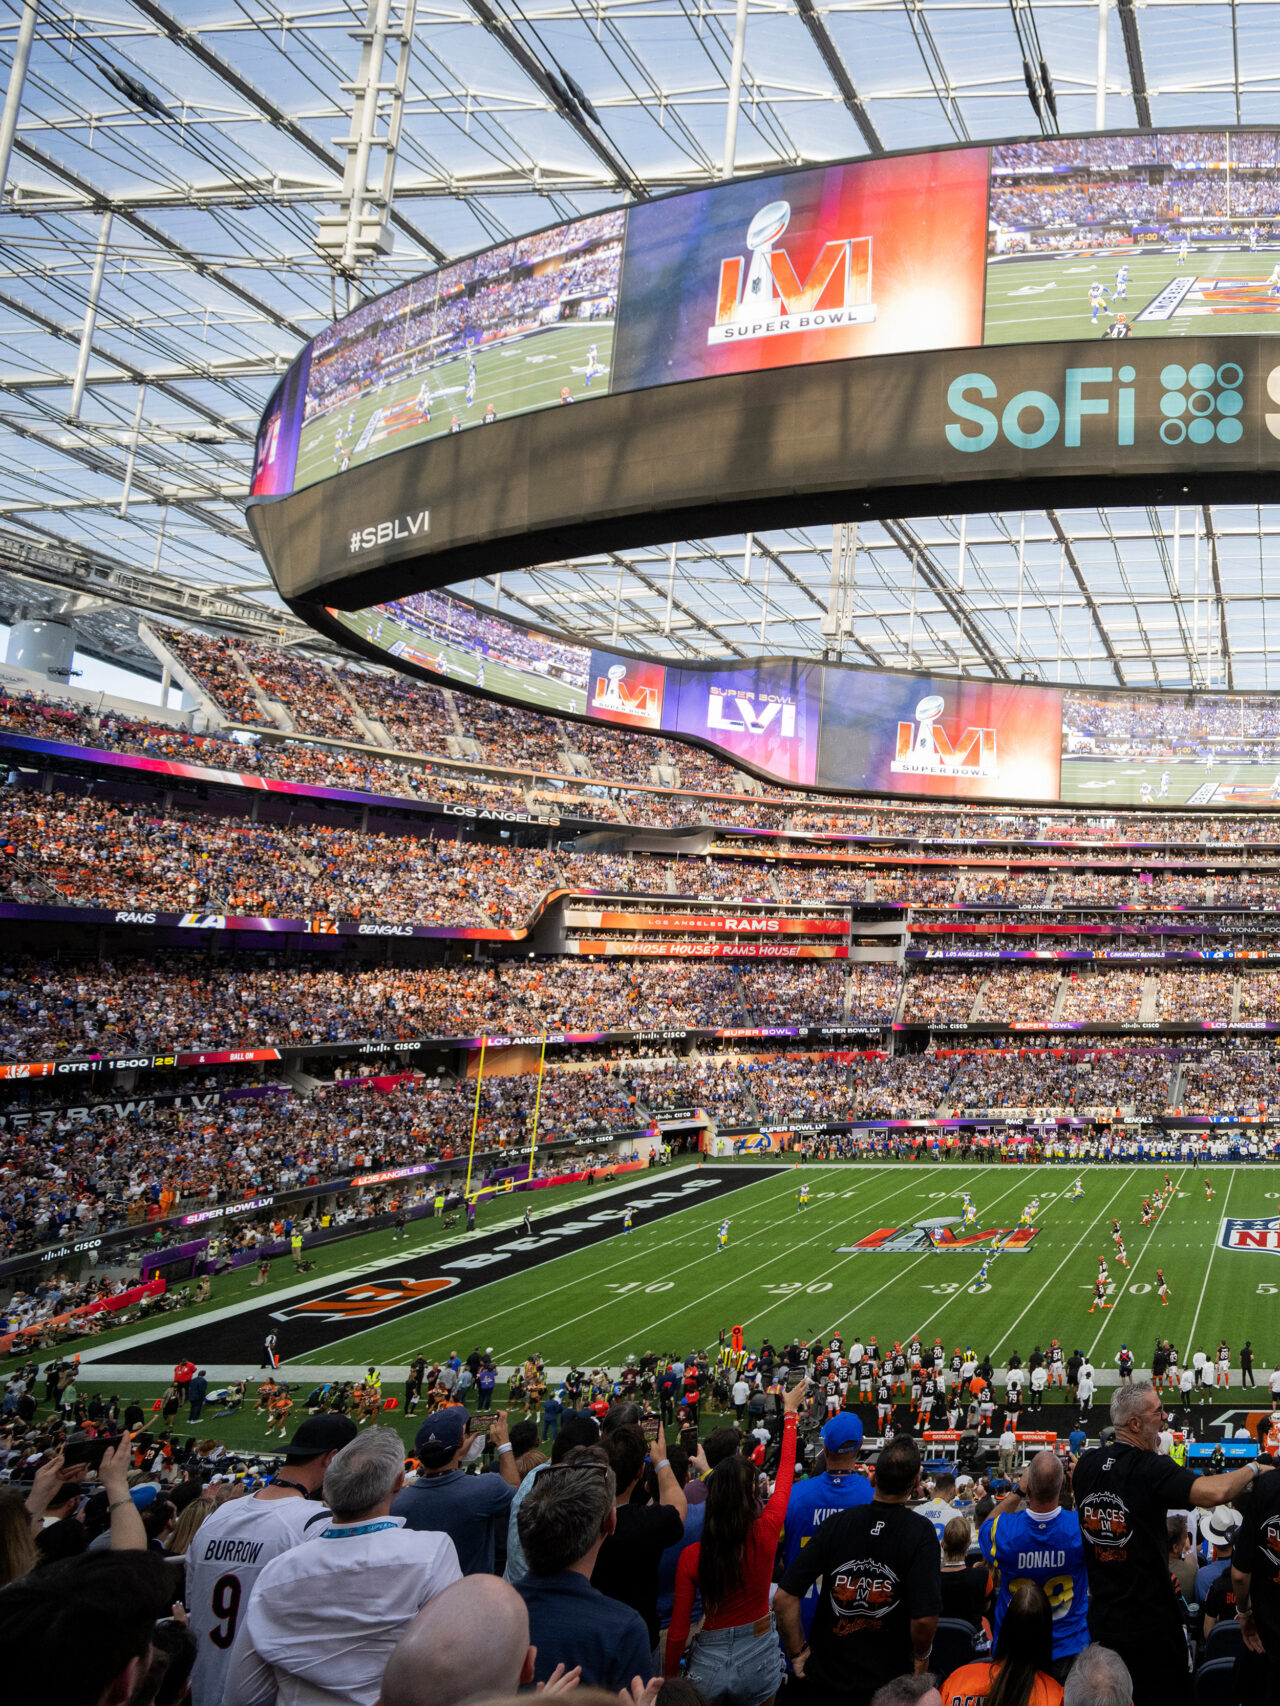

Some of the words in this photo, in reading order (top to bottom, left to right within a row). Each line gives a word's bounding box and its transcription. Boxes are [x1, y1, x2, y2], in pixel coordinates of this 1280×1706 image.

[724, 319, 791, 338] SUPER
[800, 310, 858, 328] BOWL
[945, 366, 1136, 453] SoFi
[350, 511, 429, 552] #SBLVI
[709, 687, 755, 701] SUPER
[758, 694, 797, 705] BOWL
[707, 694, 797, 737] LVI
[902, 764, 944, 774] SUPER
[951, 767, 989, 777] BOWL
[443, 805, 477, 818] LOS
[479, 810, 561, 826] ANGELES
[115, 912, 156, 924] RAMS
[674, 920, 723, 928] ANGELES
[725, 918, 779, 931] RAMS
[358, 924, 413, 936] BENGALS
[622, 944, 667, 954] WHOSE
[670, 945, 719, 955] HOUSE?
[723, 946, 757, 955] RAMS
[759, 946, 801, 957] HOUSE!
[663, 1031, 686, 1039] CISCO
[724, 1029, 759, 1037] SUPER
[762, 1028, 792, 1036] BOWL
[394, 1042, 421, 1051] CISCO
[488, 1037, 510, 1046] LOS
[58, 1064, 89, 1074] QTR
[109, 1059, 149, 1068] 15:00
[155, 1057, 174, 1066] 25
[245, 1052, 254, 1060] ON
[521, 1146, 538, 1154] CISCO
[358, 1172, 378, 1186] LOS
[378, 1165, 427, 1182] ANGELES
[187, 1208, 223, 1225] SUPER
[225, 1202, 257, 1216] BOWL
[258, 1198, 273, 1208] LVI
[440, 1178, 722, 1270] BENGALS
[74, 1239, 101, 1252] CISCO
[610, 1282, 675, 1293] 10
[767, 1282, 833, 1294] 20
[932, 1283, 992, 1294] 30
[827, 1384, 837, 1396] 57
[878, 1388, 888, 1400] 70
[925, 1382, 935, 1395] 75
[981, 1390, 991, 1402] 63
[1008, 1394, 1018, 1404] 79
[1084, 1507, 1126, 1524] PLACES
[1101, 1520, 1112, 1532] LVI
[204, 1539, 264, 1564] BURROW
[1017, 1550, 1066, 1570] DONALD
[834, 1574, 893, 1593] PLACES
[856, 1588, 870, 1602] LVI
[209, 1574, 241, 1650] 9
